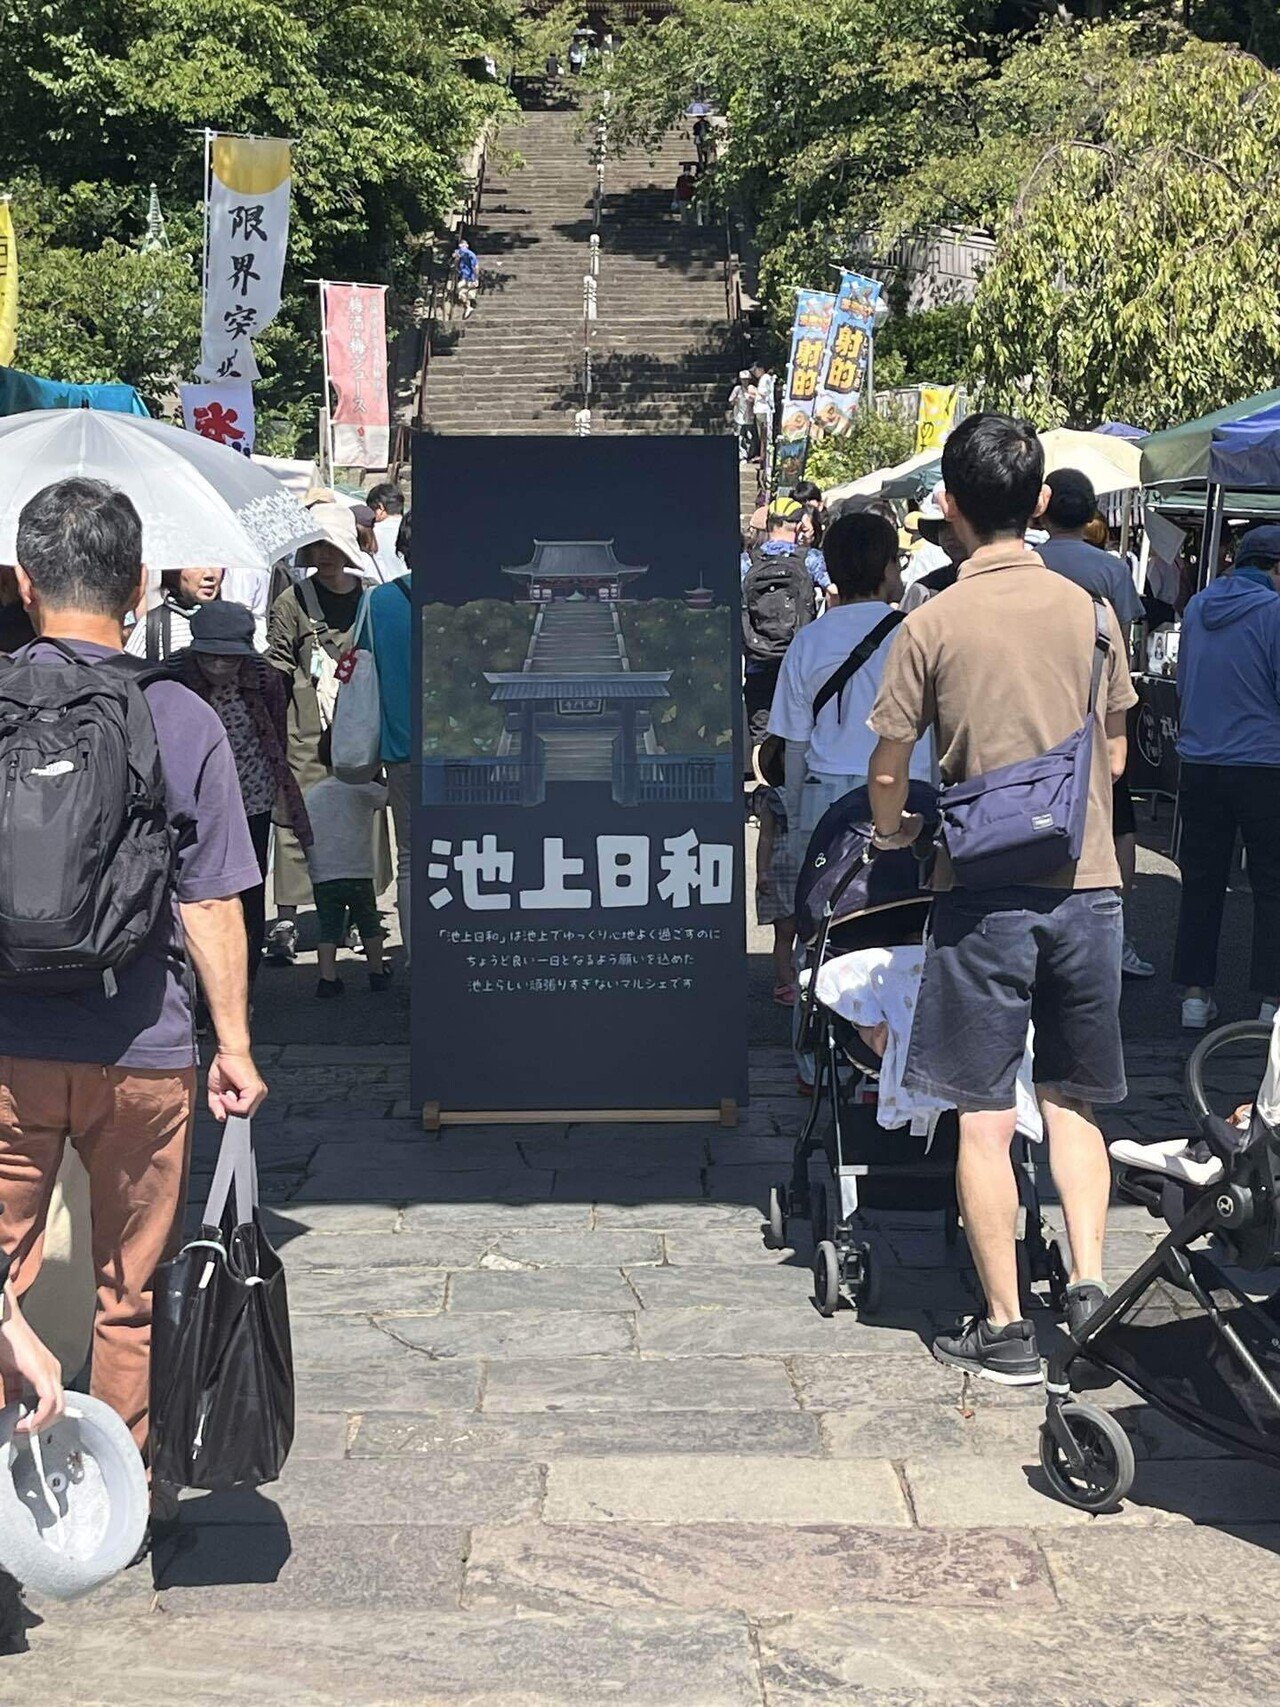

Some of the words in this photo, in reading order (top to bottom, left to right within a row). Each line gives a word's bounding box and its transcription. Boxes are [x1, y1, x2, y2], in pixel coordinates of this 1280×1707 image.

[428, 828, 734, 911] 池上日和
[466, 953, 695, 967] ちょうど良い一日となるよう願いを込めた
[468, 977, 693, 992] 池上らしい頑張りすぎないマルシェです
